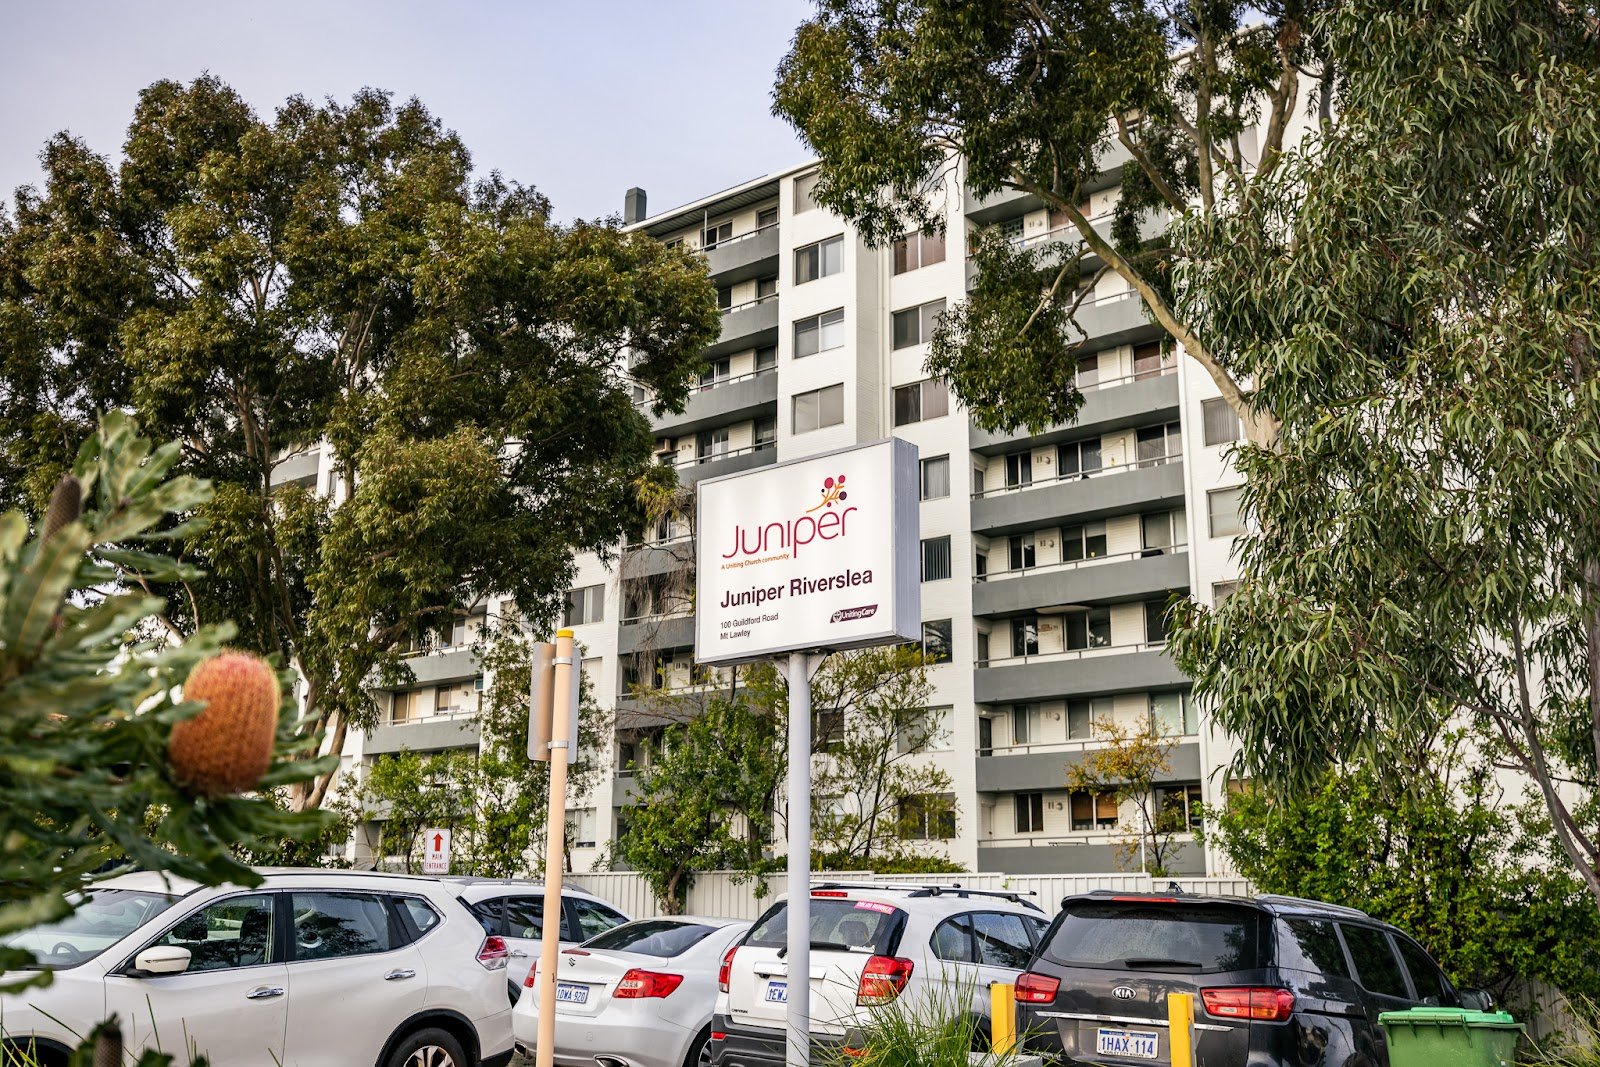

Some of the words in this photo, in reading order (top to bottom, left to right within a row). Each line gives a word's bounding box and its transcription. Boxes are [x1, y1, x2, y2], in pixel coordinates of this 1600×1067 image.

[722, 507, 858, 559] Juniper
[762, 553, 790, 563] community
[720, 584, 785, 608] Juniper
[790, 569, 873, 597] Riverslea
[841, 608, 875, 619] UnitingCare
[721, 620, 731, 629] 100
[733, 616, 761, 627] Guildford
[762, 613, 779, 622] Road
[720, 632, 728, 640] Mt
[730, 629, 751, 639] Lawley
[426, 862, 447, 870] ENTRANCE
[1115, 988, 1132, 998] KIA
